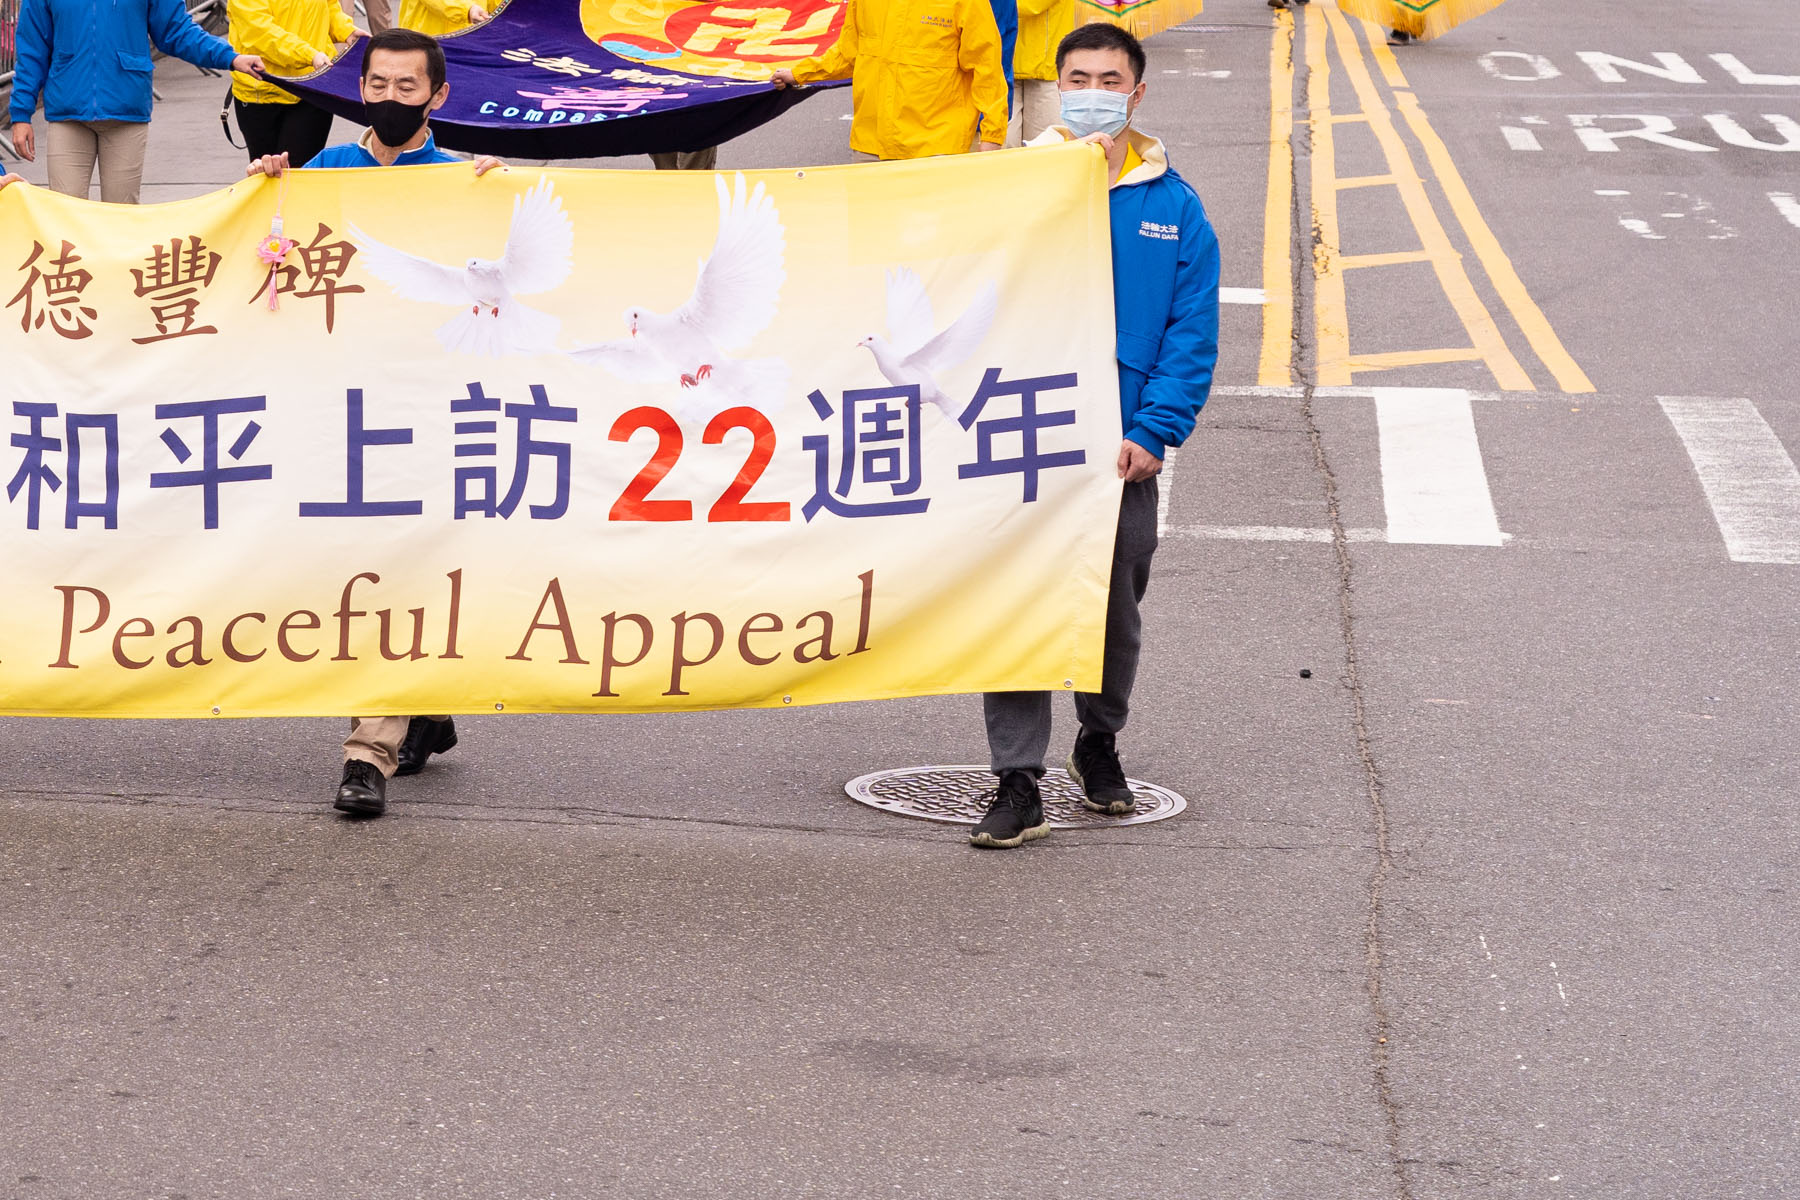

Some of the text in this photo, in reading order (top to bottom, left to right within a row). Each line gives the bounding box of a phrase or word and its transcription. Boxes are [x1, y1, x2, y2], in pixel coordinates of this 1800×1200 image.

[478, 100, 648, 124] Compas
[1138, 229, 1179, 241] FALUN DAFA
[1140, 220, 1179, 234] 法輪大法
[46, 567, 464, 671] Peaceful
[505, 567, 875, 698] Appeal
